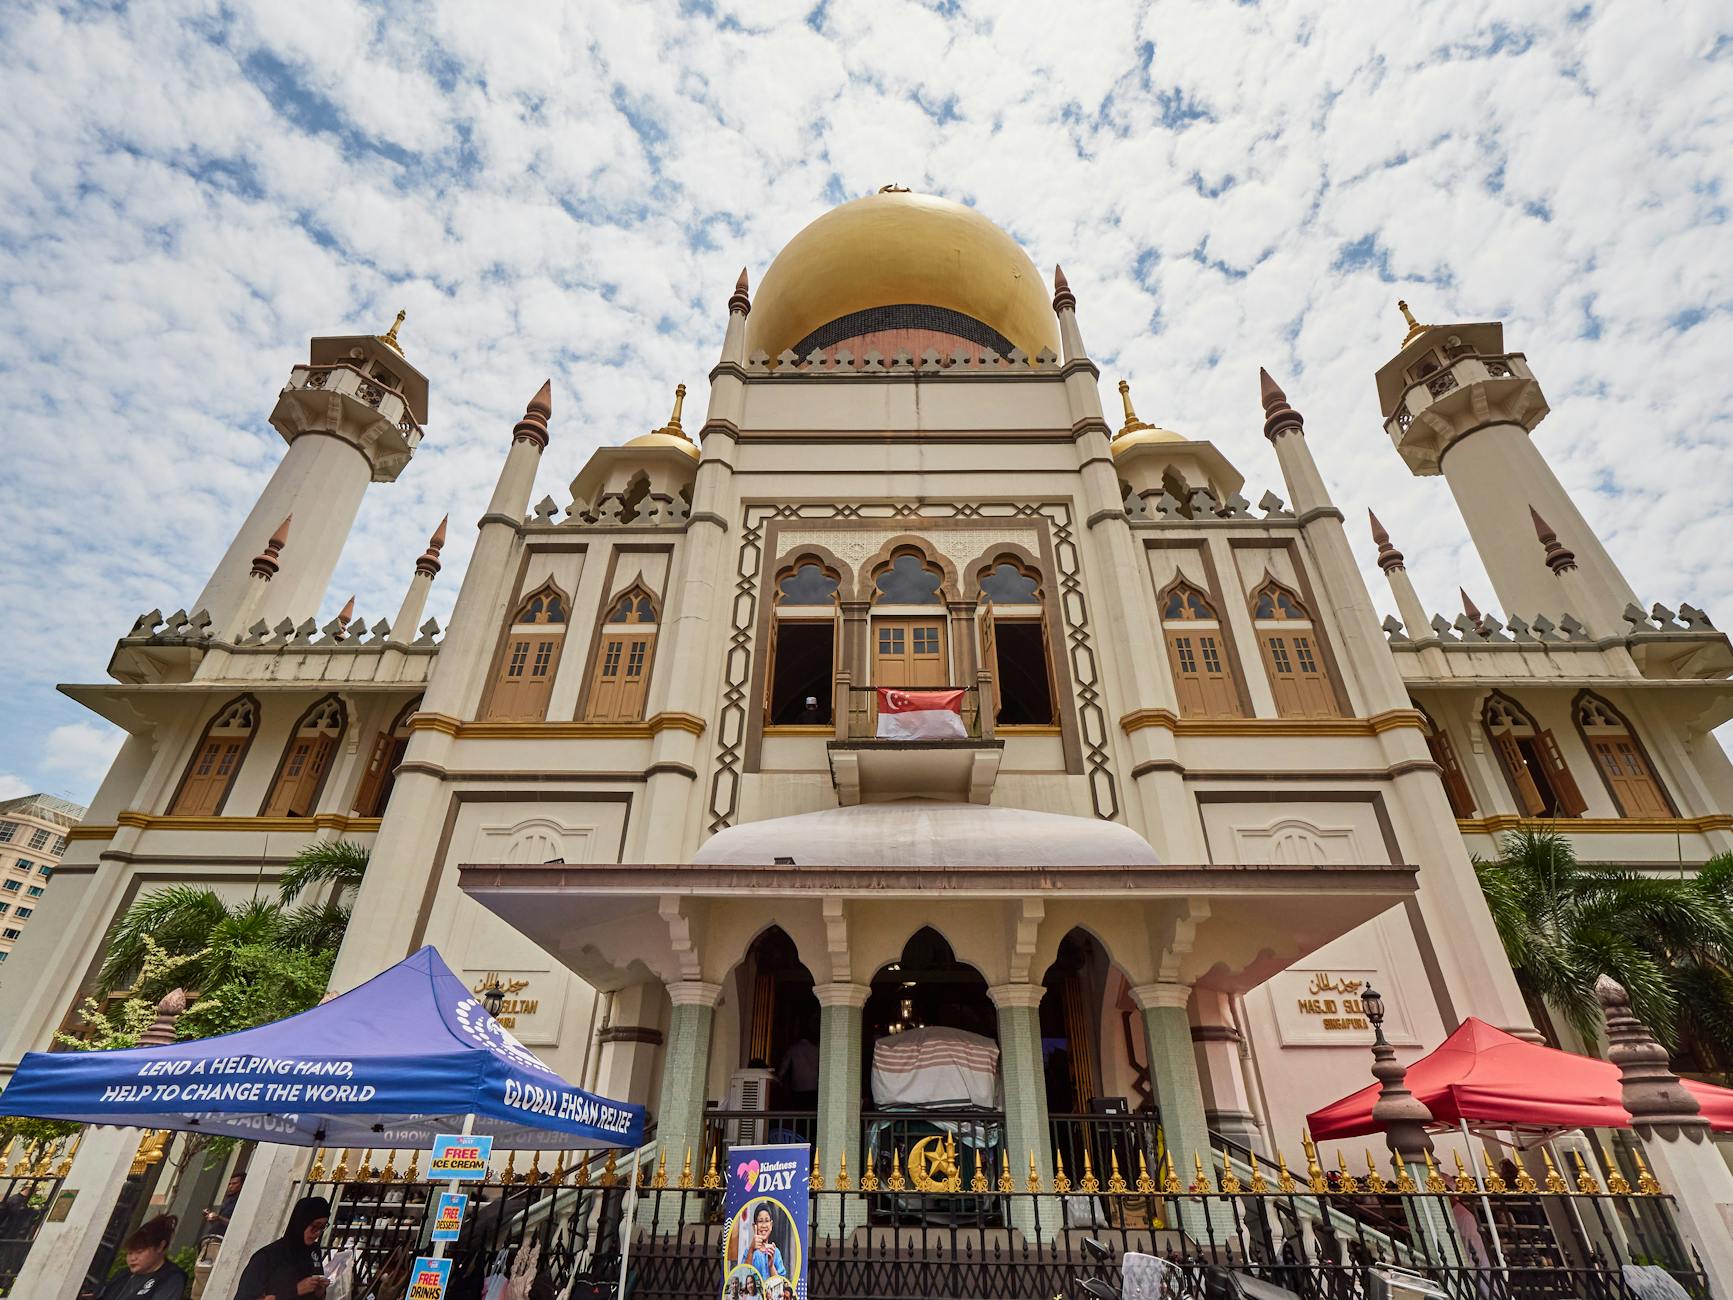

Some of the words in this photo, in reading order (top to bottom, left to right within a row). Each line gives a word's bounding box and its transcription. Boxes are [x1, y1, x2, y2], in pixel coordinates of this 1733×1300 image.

[501, 1000, 539, 1014] SULTAN
[1298, 999, 1338, 1014] MASJID
[1323, 1018, 1369, 1030] SINGAPURA
[138, 1060, 192, 1076] LEND
[190, 1059, 206, 1075] A
[209, 1056, 295, 1075] HELPING
[293, 1061, 354, 1080] HAND,
[99, 1085, 152, 1102] HELP
[152, 1084, 180, 1101] TO
[181, 1083, 264, 1101] CHANGE
[264, 1084, 303, 1102] THE
[304, 1085, 376, 1102] WORLD
[503, 1078, 558, 1117] GLOBAL
[557, 1092, 599, 1127] EHSAN
[597, 1105, 634, 1134] RELIEF
[445, 1148, 479, 1160] FREE
[433, 1160, 449, 1169] ICE
[450, 1160, 485, 1169] CREAM
[760, 1161, 797, 1172] Kindness
[758, 1170, 797, 1193] DAY
[443, 1207, 460, 1219] FREE
[418, 1273, 440, 1286] FREE
[410, 1285, 442, 1300] DRINKS
